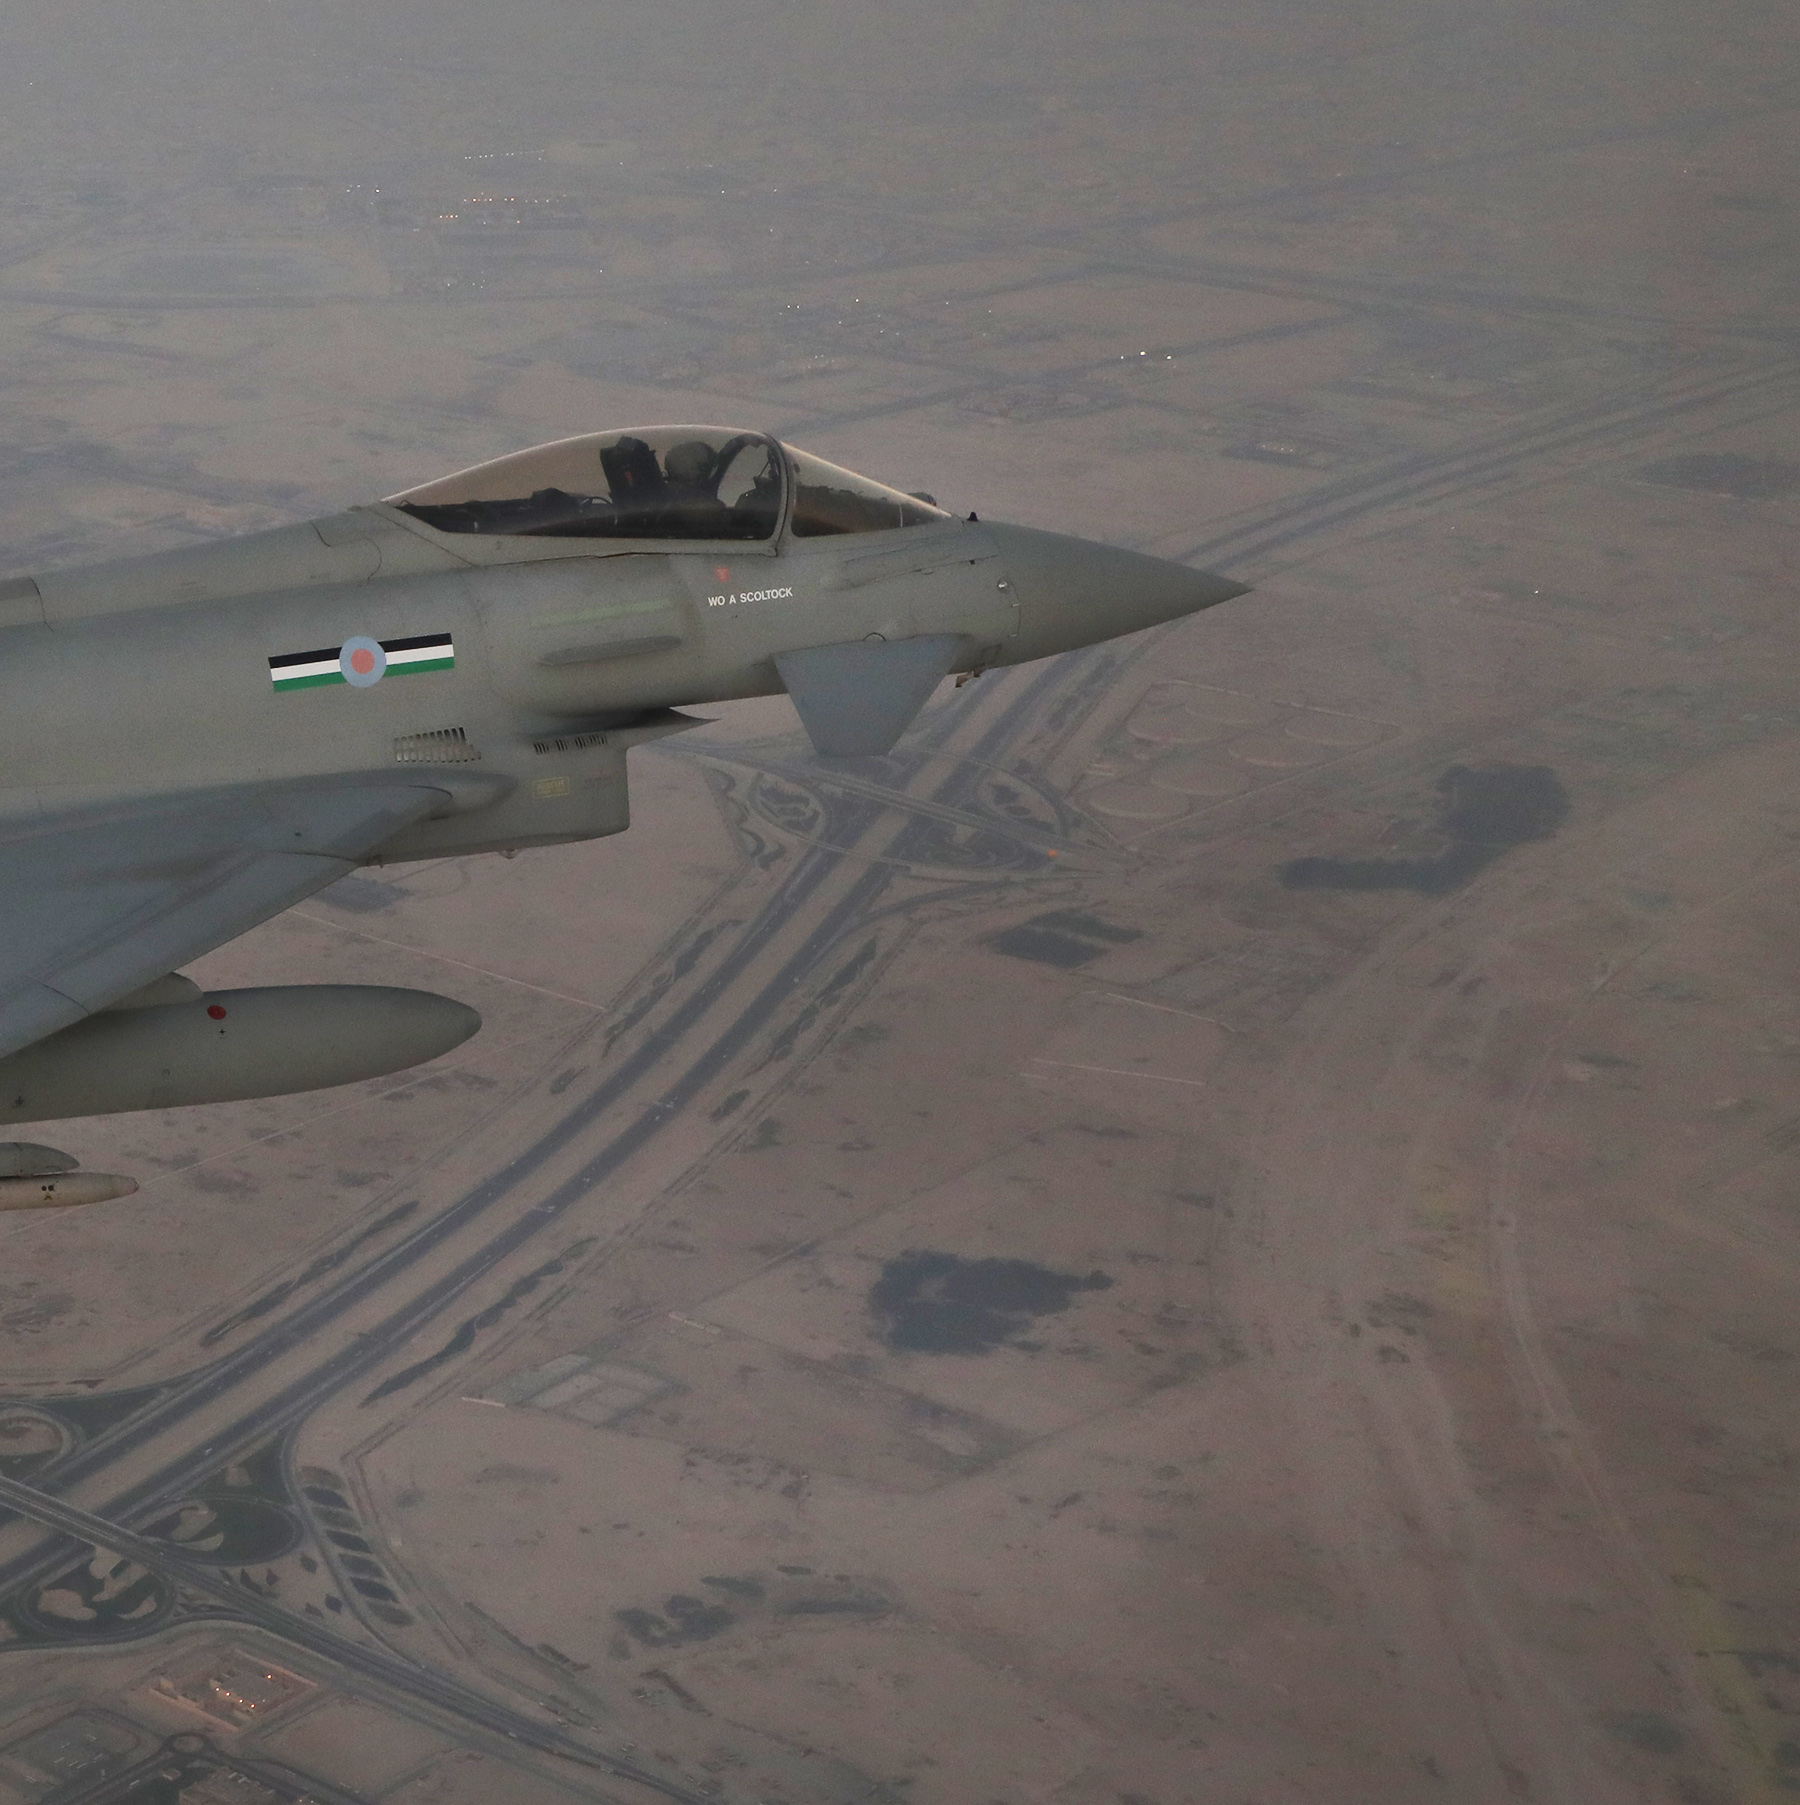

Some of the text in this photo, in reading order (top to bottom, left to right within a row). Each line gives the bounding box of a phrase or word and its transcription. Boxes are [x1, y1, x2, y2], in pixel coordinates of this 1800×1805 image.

[708, 587, 793, 606] WO A SCOLTOCK
